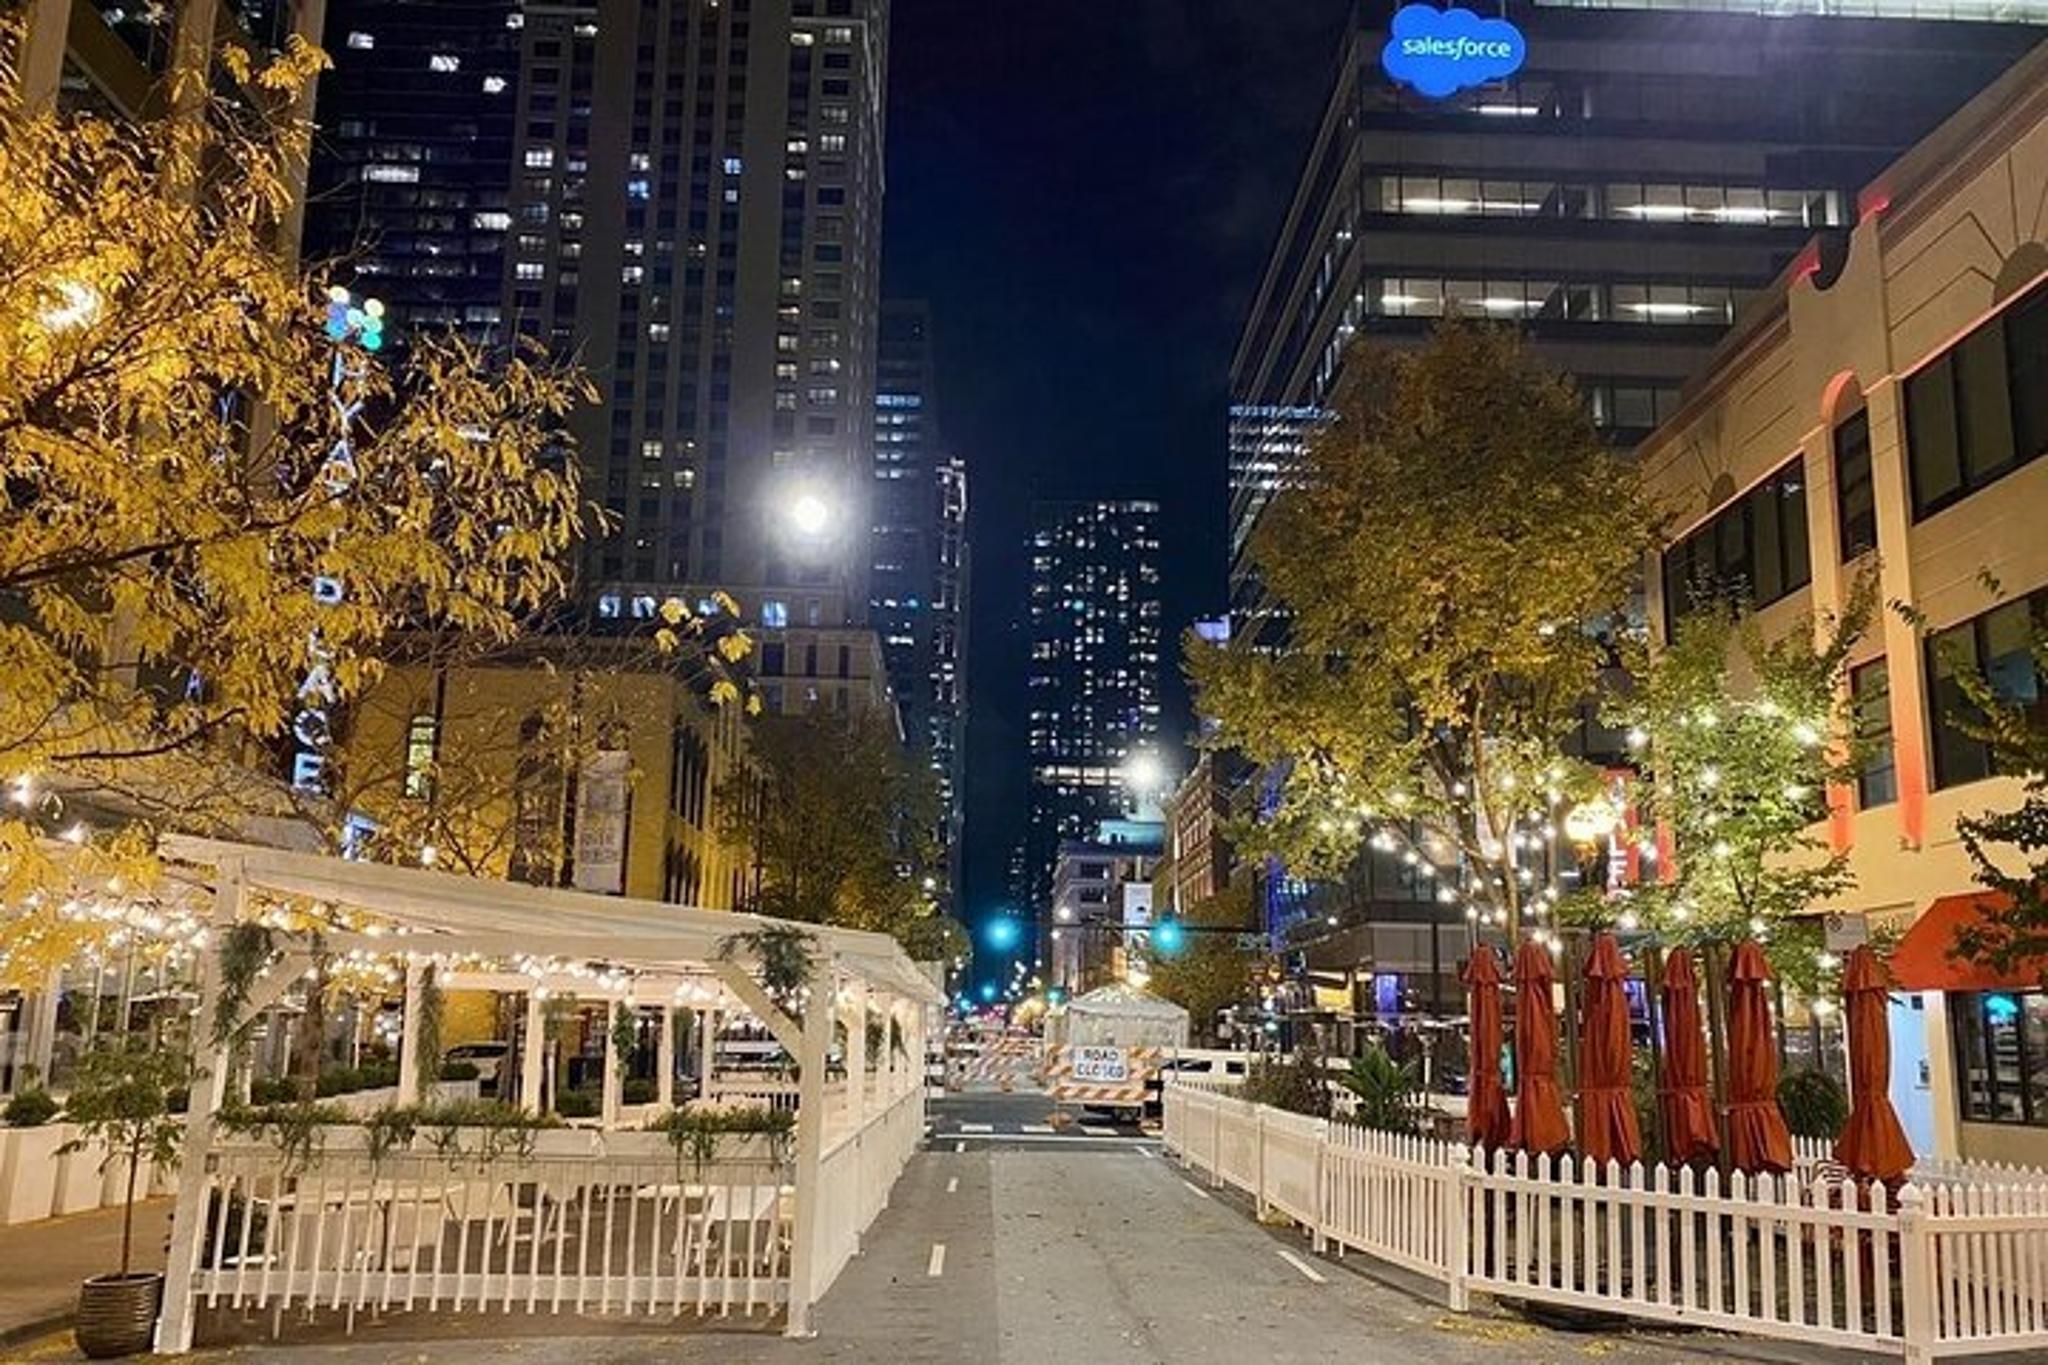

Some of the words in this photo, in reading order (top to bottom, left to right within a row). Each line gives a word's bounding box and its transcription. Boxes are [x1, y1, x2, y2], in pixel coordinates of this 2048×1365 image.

[1402, 36, 1511, 60] salesforce
[1083, 1048, 1119, 1061] ROAD
[1076, 1062, 1125, 1079] CLOSED
